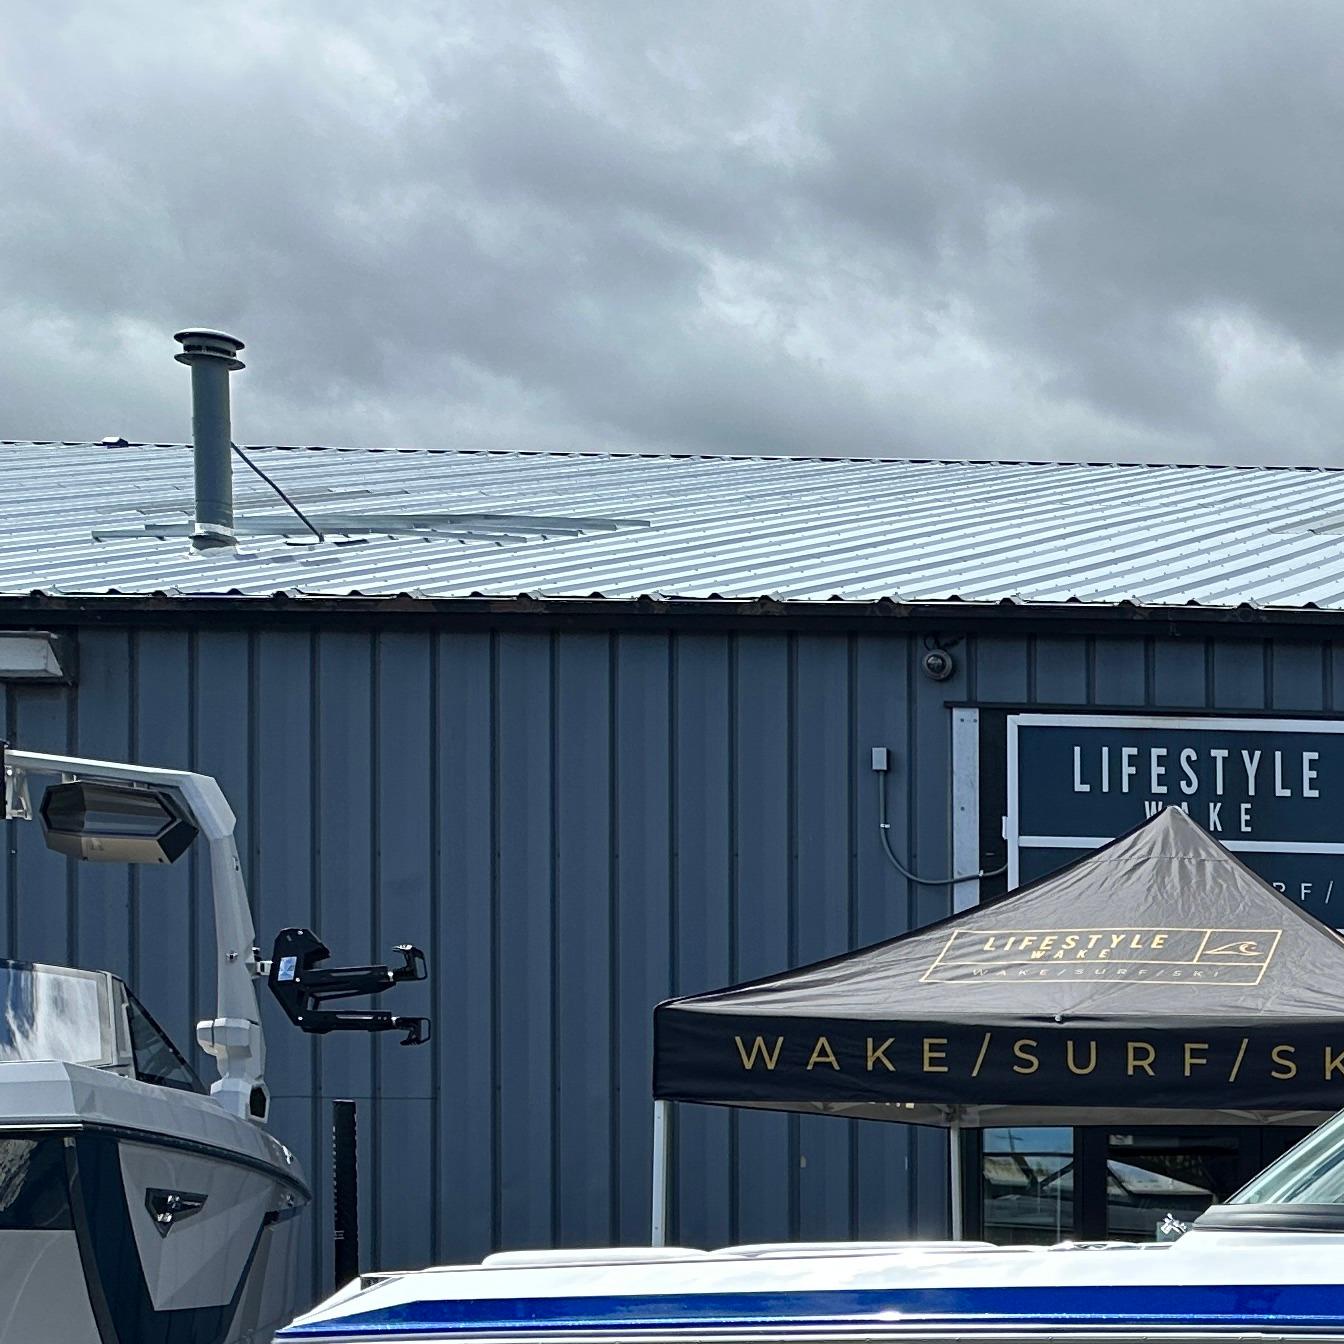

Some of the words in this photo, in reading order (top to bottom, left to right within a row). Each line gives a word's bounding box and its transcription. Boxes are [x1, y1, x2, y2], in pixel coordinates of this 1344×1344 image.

[1073, 745, 1320, 799] LIFESTYLE
[983, 933, 1170, 952] LIFESTYLE
[1030, 948, 1113, 960] WAKE
[972, 967, 1221, 978] WAKE/SURF/SKI
